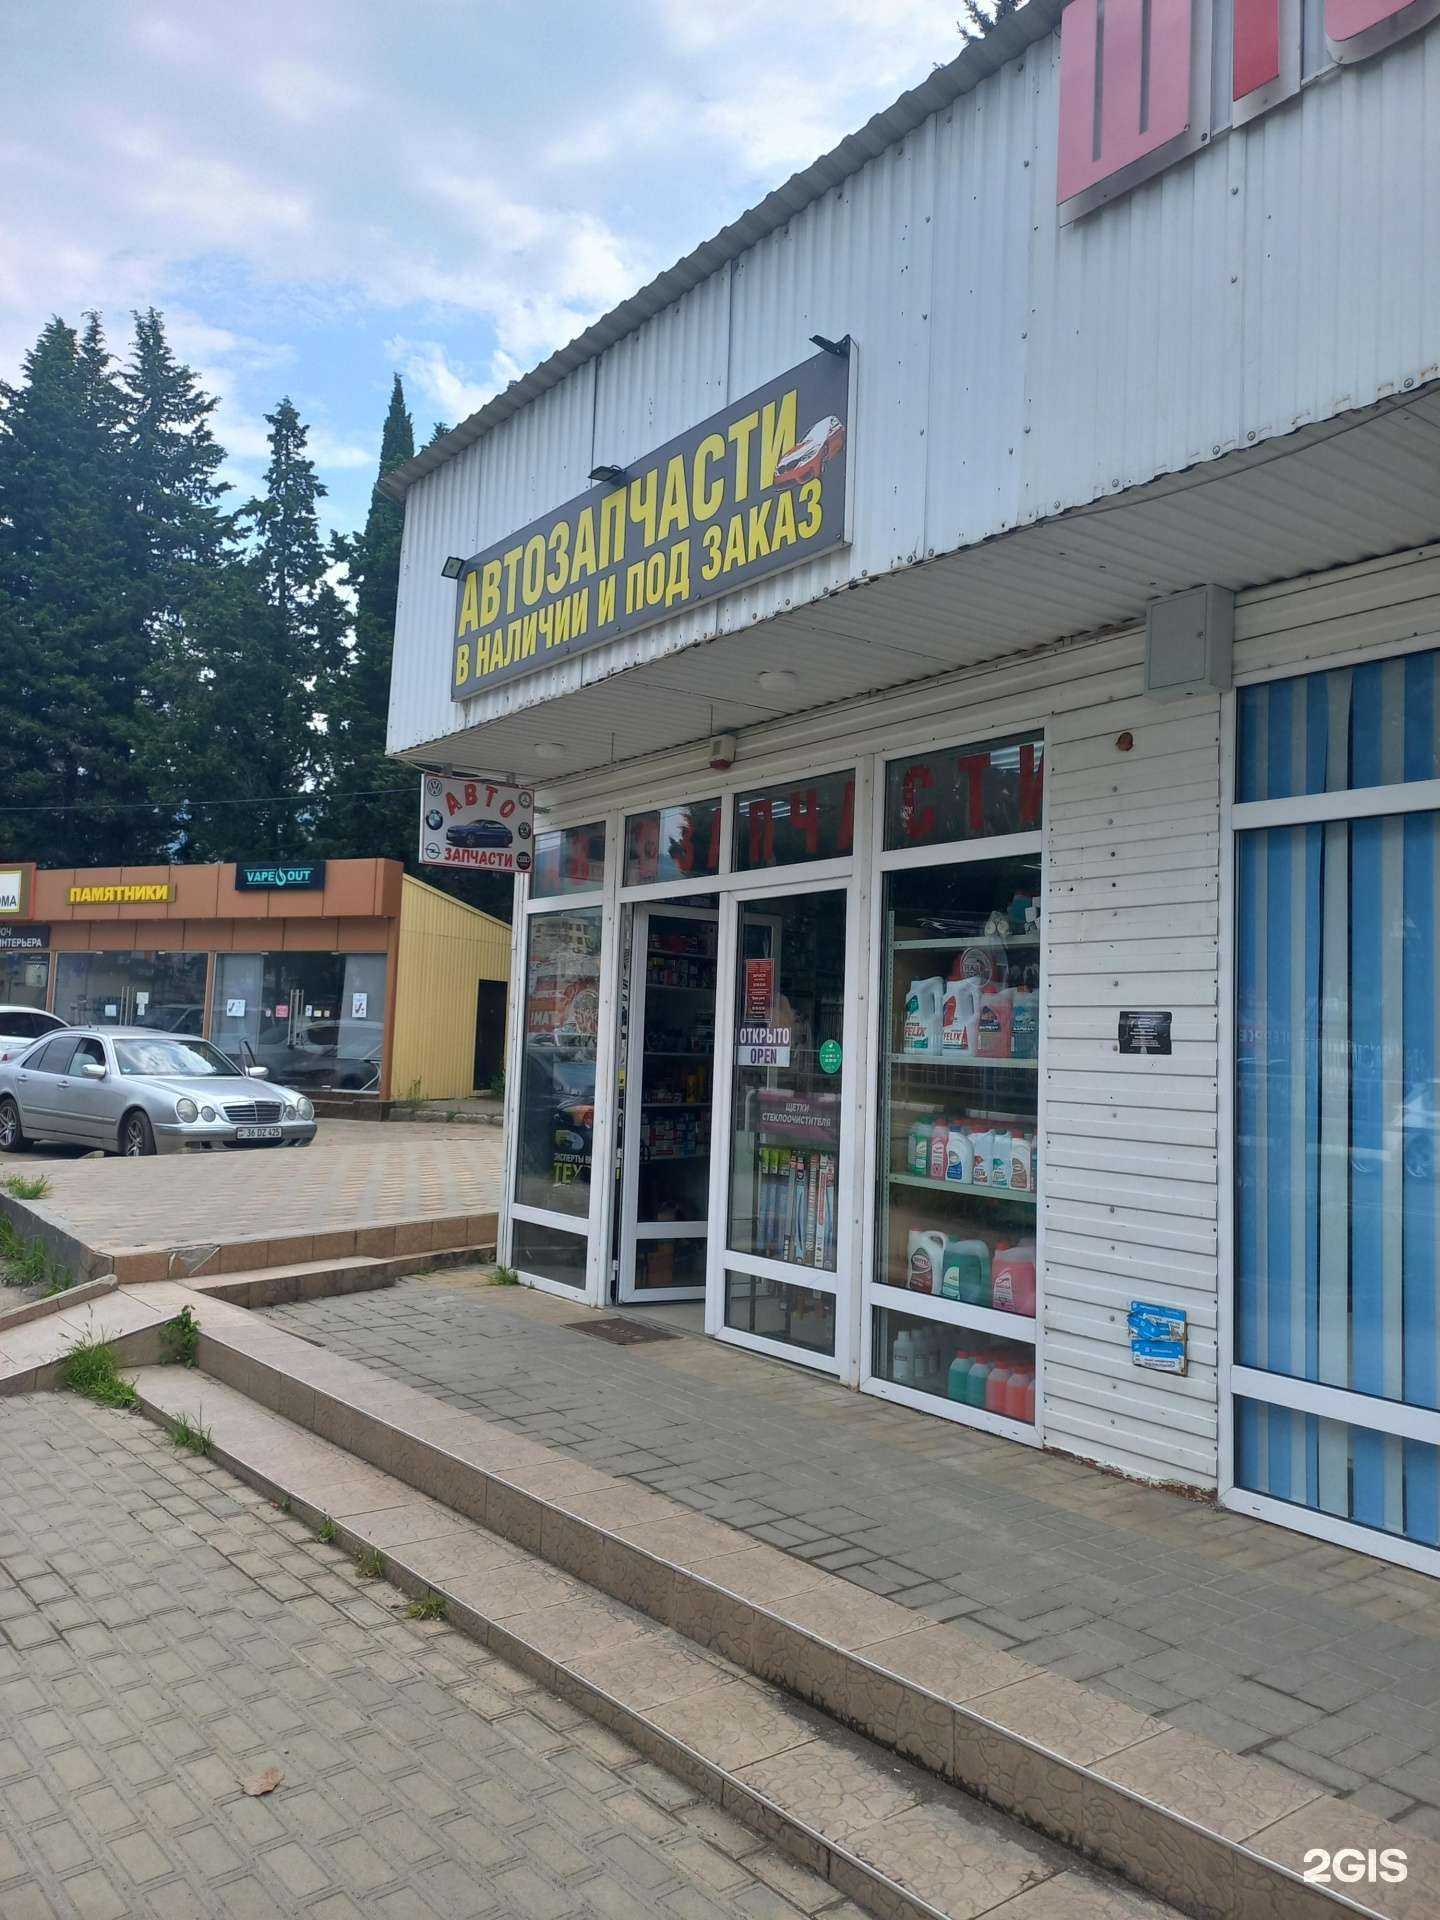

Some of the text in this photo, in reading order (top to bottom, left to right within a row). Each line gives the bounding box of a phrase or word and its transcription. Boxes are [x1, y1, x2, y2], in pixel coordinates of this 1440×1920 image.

[458, 389, 798, 638] АВТОЗАПЧАСТИ
[455, 478, 823, 687] В НАЛИЧИИ И ПОД ЗАКАЗ
[445, 783, 516, 818] АВТО
[444, 847, 513, 868] ЗАПЧАСТИ
[246, 869, 311, 882] VAPE OUT
[0, 895, 17, 907] МА
[70, 884, 168, 902] ПАМЯТНИКИ
[739, 1027, 790, 1045] ОТКРЫТО
[750, 1048, 777, 1064] OPEN
[785, 1102, 810, 1114] ЩЕТКИ
